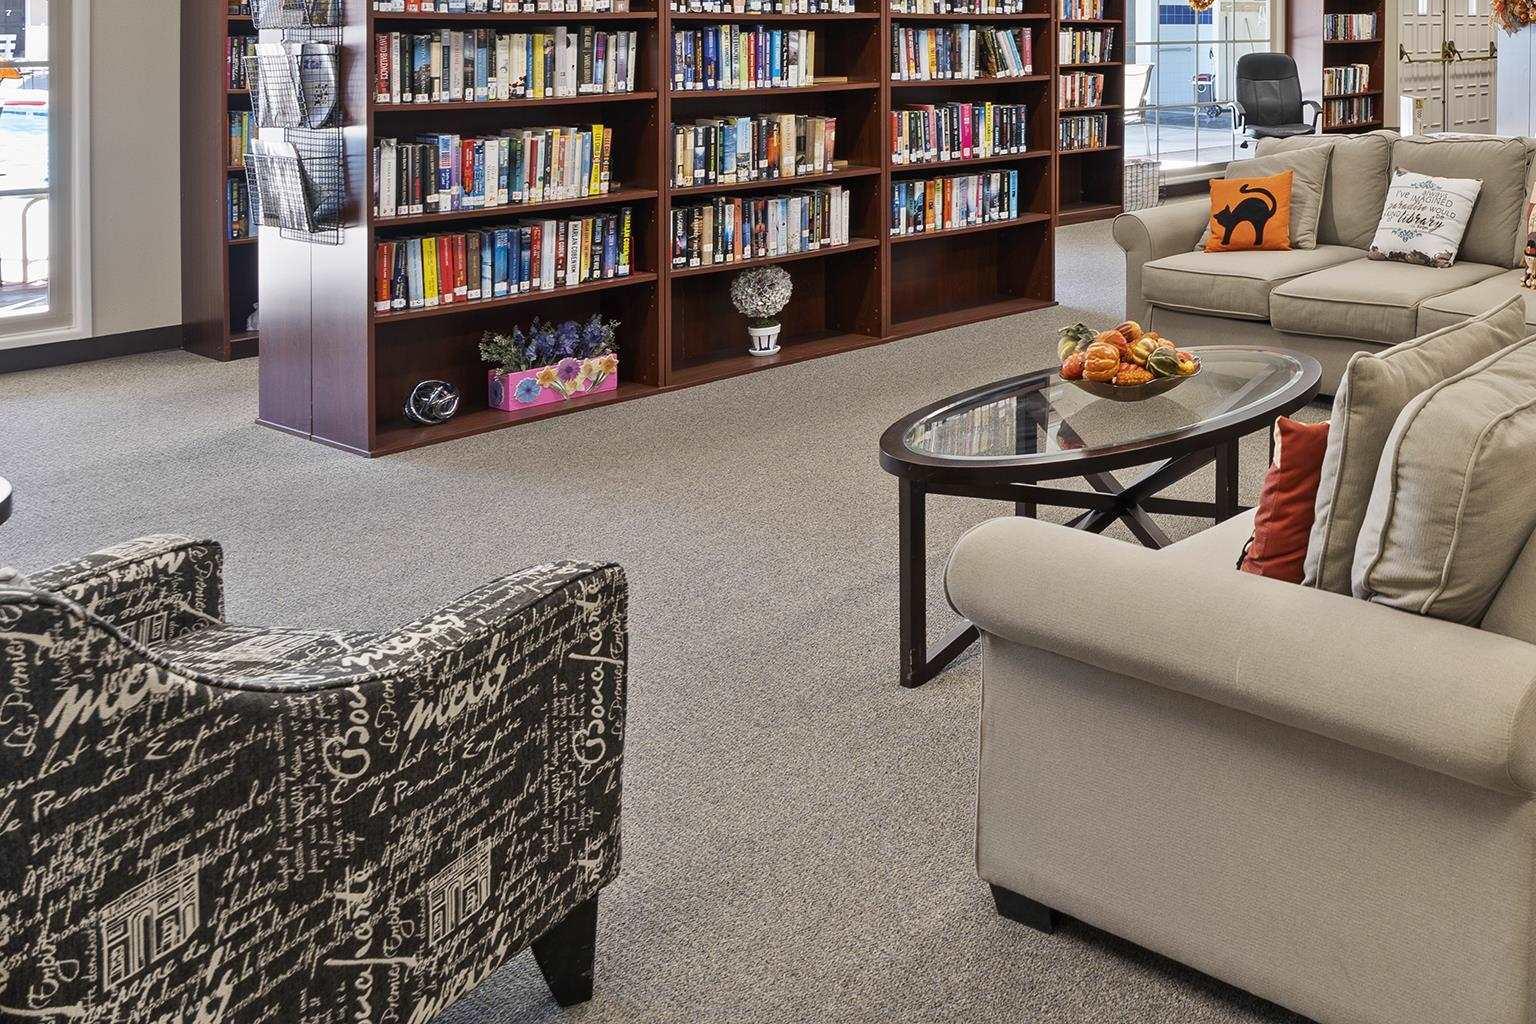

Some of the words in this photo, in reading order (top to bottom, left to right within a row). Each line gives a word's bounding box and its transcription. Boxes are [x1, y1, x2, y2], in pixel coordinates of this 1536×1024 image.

[379, 36, 387, 52] DAVID
[380, 53, 388, 80] BALDACCI
[1411, 195, 1454, 207] IMAGINED
[1430, 206, 1456, 218] WOULD
[1398, 210, 1444, 233] library
